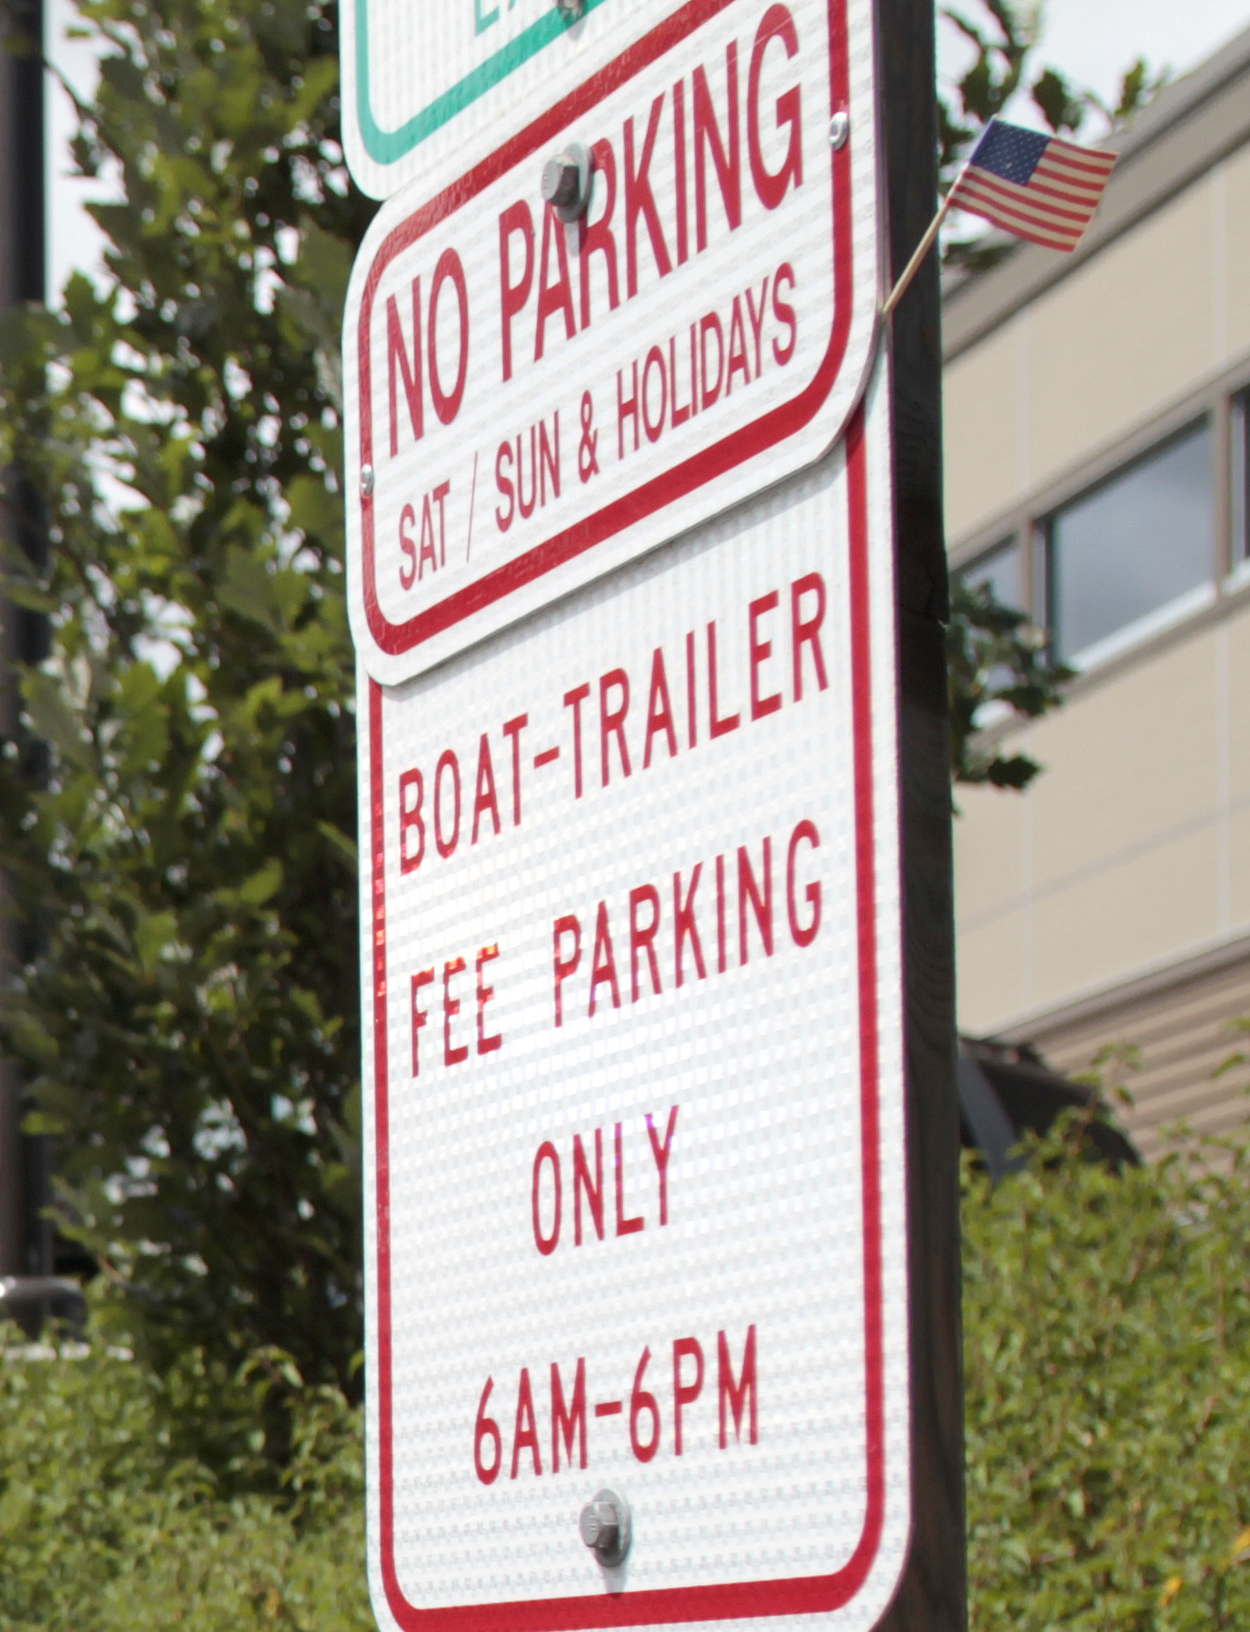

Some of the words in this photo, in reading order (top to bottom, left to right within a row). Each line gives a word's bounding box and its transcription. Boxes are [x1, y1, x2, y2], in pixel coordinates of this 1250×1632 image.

[387, 246, 469, 458] NO
[498, 2, 804, 382] PARKING
[399, 480, 451, 591] SAT
[495, 411, 561, 533] SUN
[578, 389, 599, 485] &
[616, 261, 797, 461] HOLIDAYS
[398, 571, 830, 876] BOAT-TRAILER
[409, 942, 503, 1079] FEE
[552, 819, 823, 1029] PARKING
[531, 1103, 680, 1257] ONLY
[473, 1323, 759, 1486] 6AM-6PM
